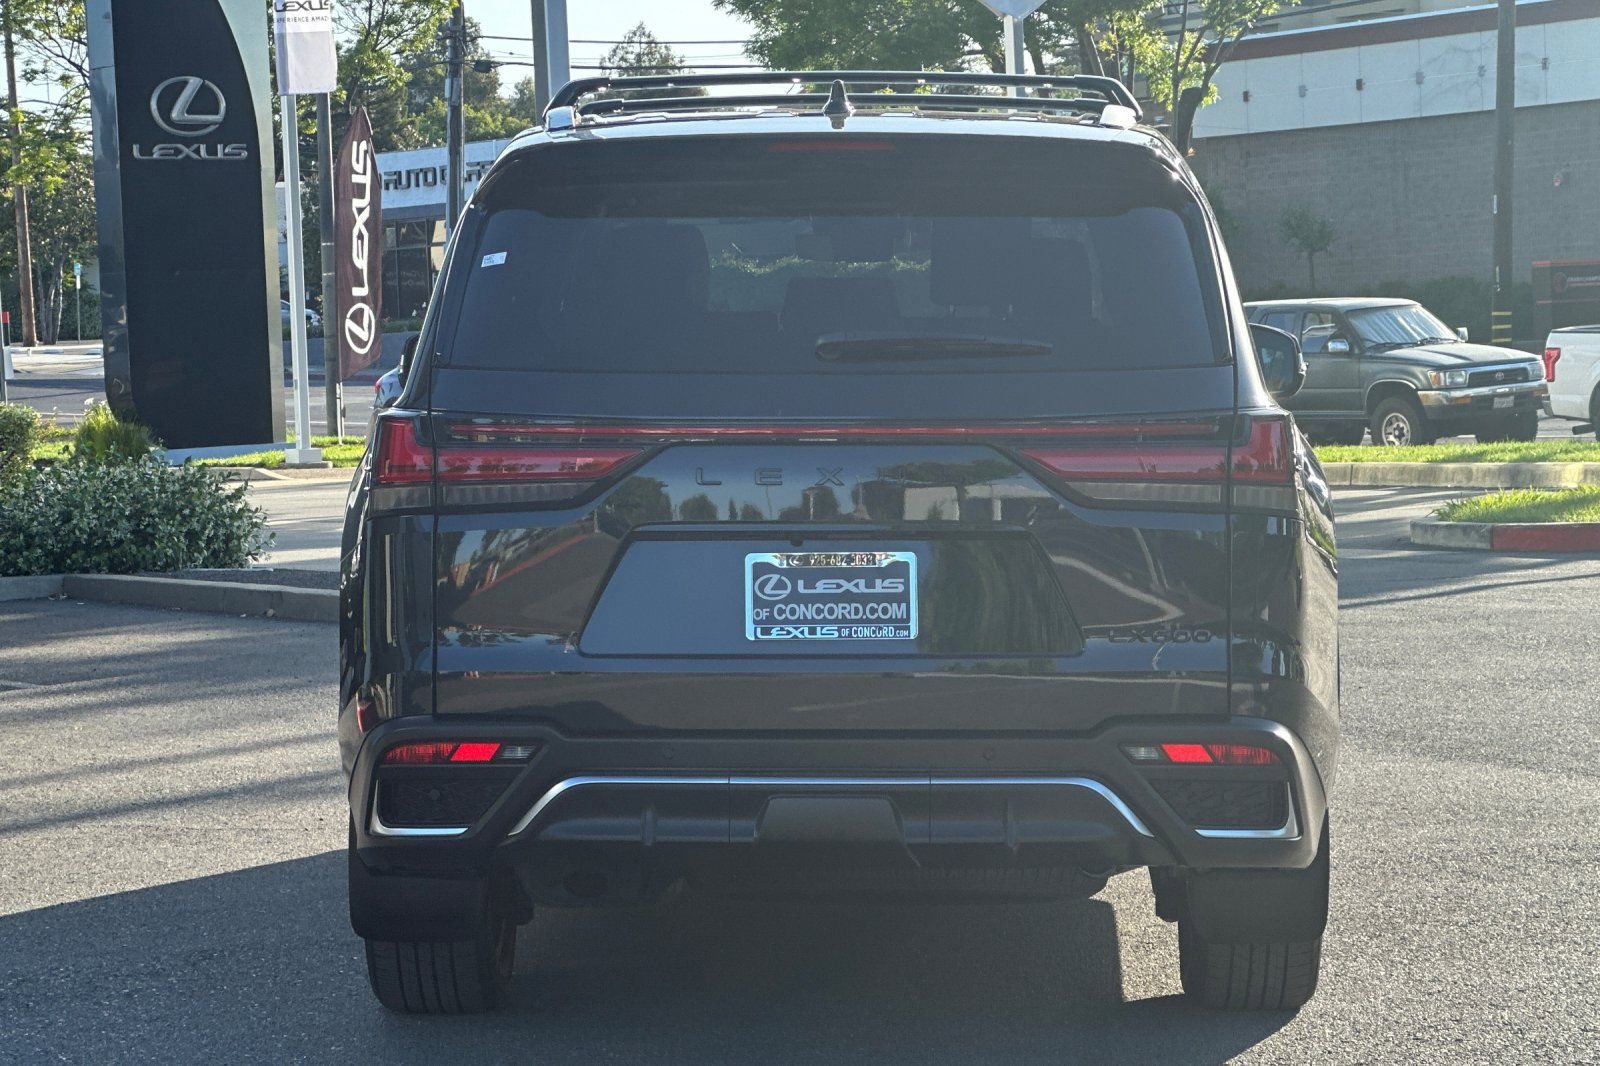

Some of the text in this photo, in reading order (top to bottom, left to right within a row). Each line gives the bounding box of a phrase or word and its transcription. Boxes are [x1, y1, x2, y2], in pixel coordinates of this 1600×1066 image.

[132, 143, 248, 160] LEXUS
[351, 140, 372, 297] LEXUS
[797, 578, 905, 594] LEXUS
[753, 603, 907, 621] OF CONCORD.COM
[756, 626, 839, 639] LEXUS
[841, 628, 850, 637] OF
